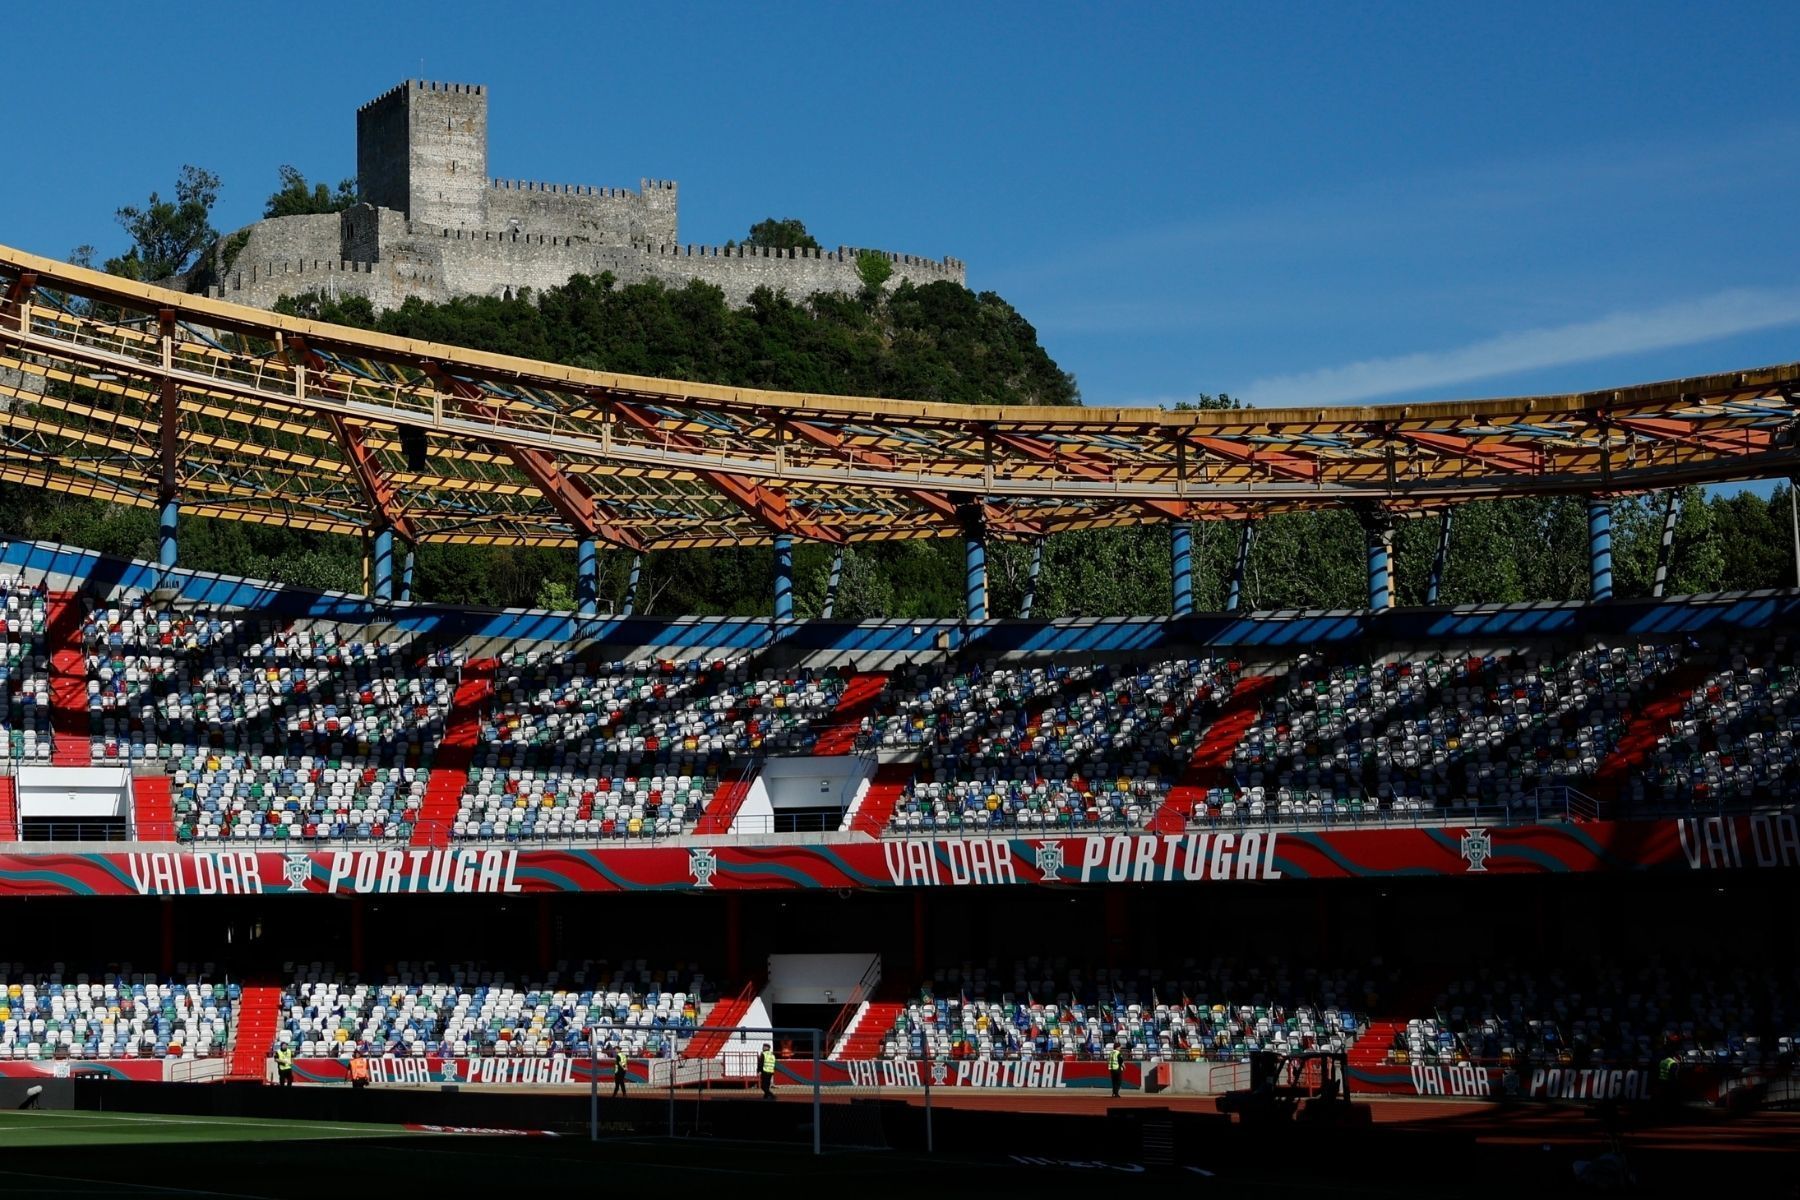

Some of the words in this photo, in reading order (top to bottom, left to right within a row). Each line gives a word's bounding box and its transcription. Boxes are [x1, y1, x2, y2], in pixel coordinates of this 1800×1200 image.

[884, 841, 940, 886] VAI
[947, 839, 1016, 885] DAR
[1081, 832, 1281, 883] PORTUGAL
[1677, 816, 1743, 869] VAI
[128, 853, 186, 894] VAI
[194, 852, 263, 894] DAR
[328, 850, 522, 893] PORTUGAL
[364, 1058, 388, 1082] AI
[392, 1058, 431, 1082] DAR
[466, 1058, 575, 1083] PORTUGAL
[847, 1060, 878, 1086] VAI
[882, 1060, 921, 1086] DAR
[956, 1060, 1066, 1088] PORTUGAL
[1411, 1066, 1445, 1095] VAI
[1449, 1066, 1491, 1096] DAR
[1530, 1069, 1650, 1100] PORTUGAL
